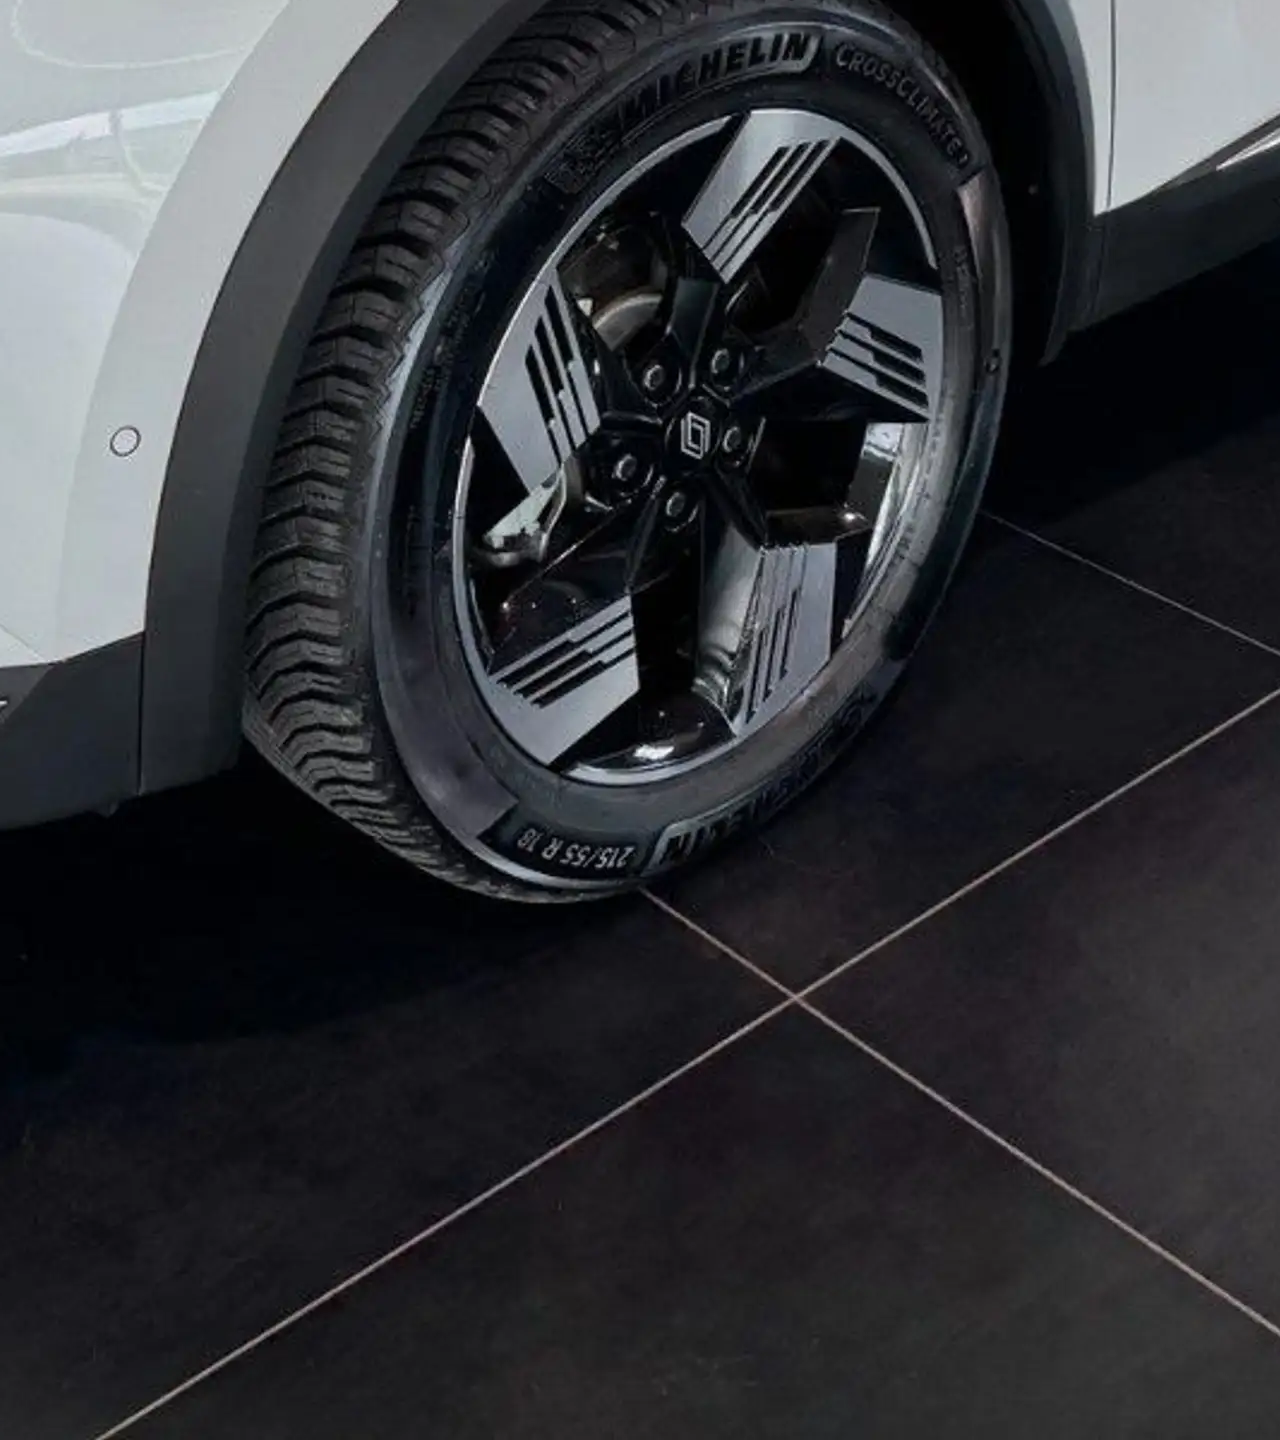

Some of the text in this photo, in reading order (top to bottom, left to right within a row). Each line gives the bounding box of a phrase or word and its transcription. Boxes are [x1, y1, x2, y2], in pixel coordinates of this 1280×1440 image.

[517, 828, 636, 869] 215/55 R 18
